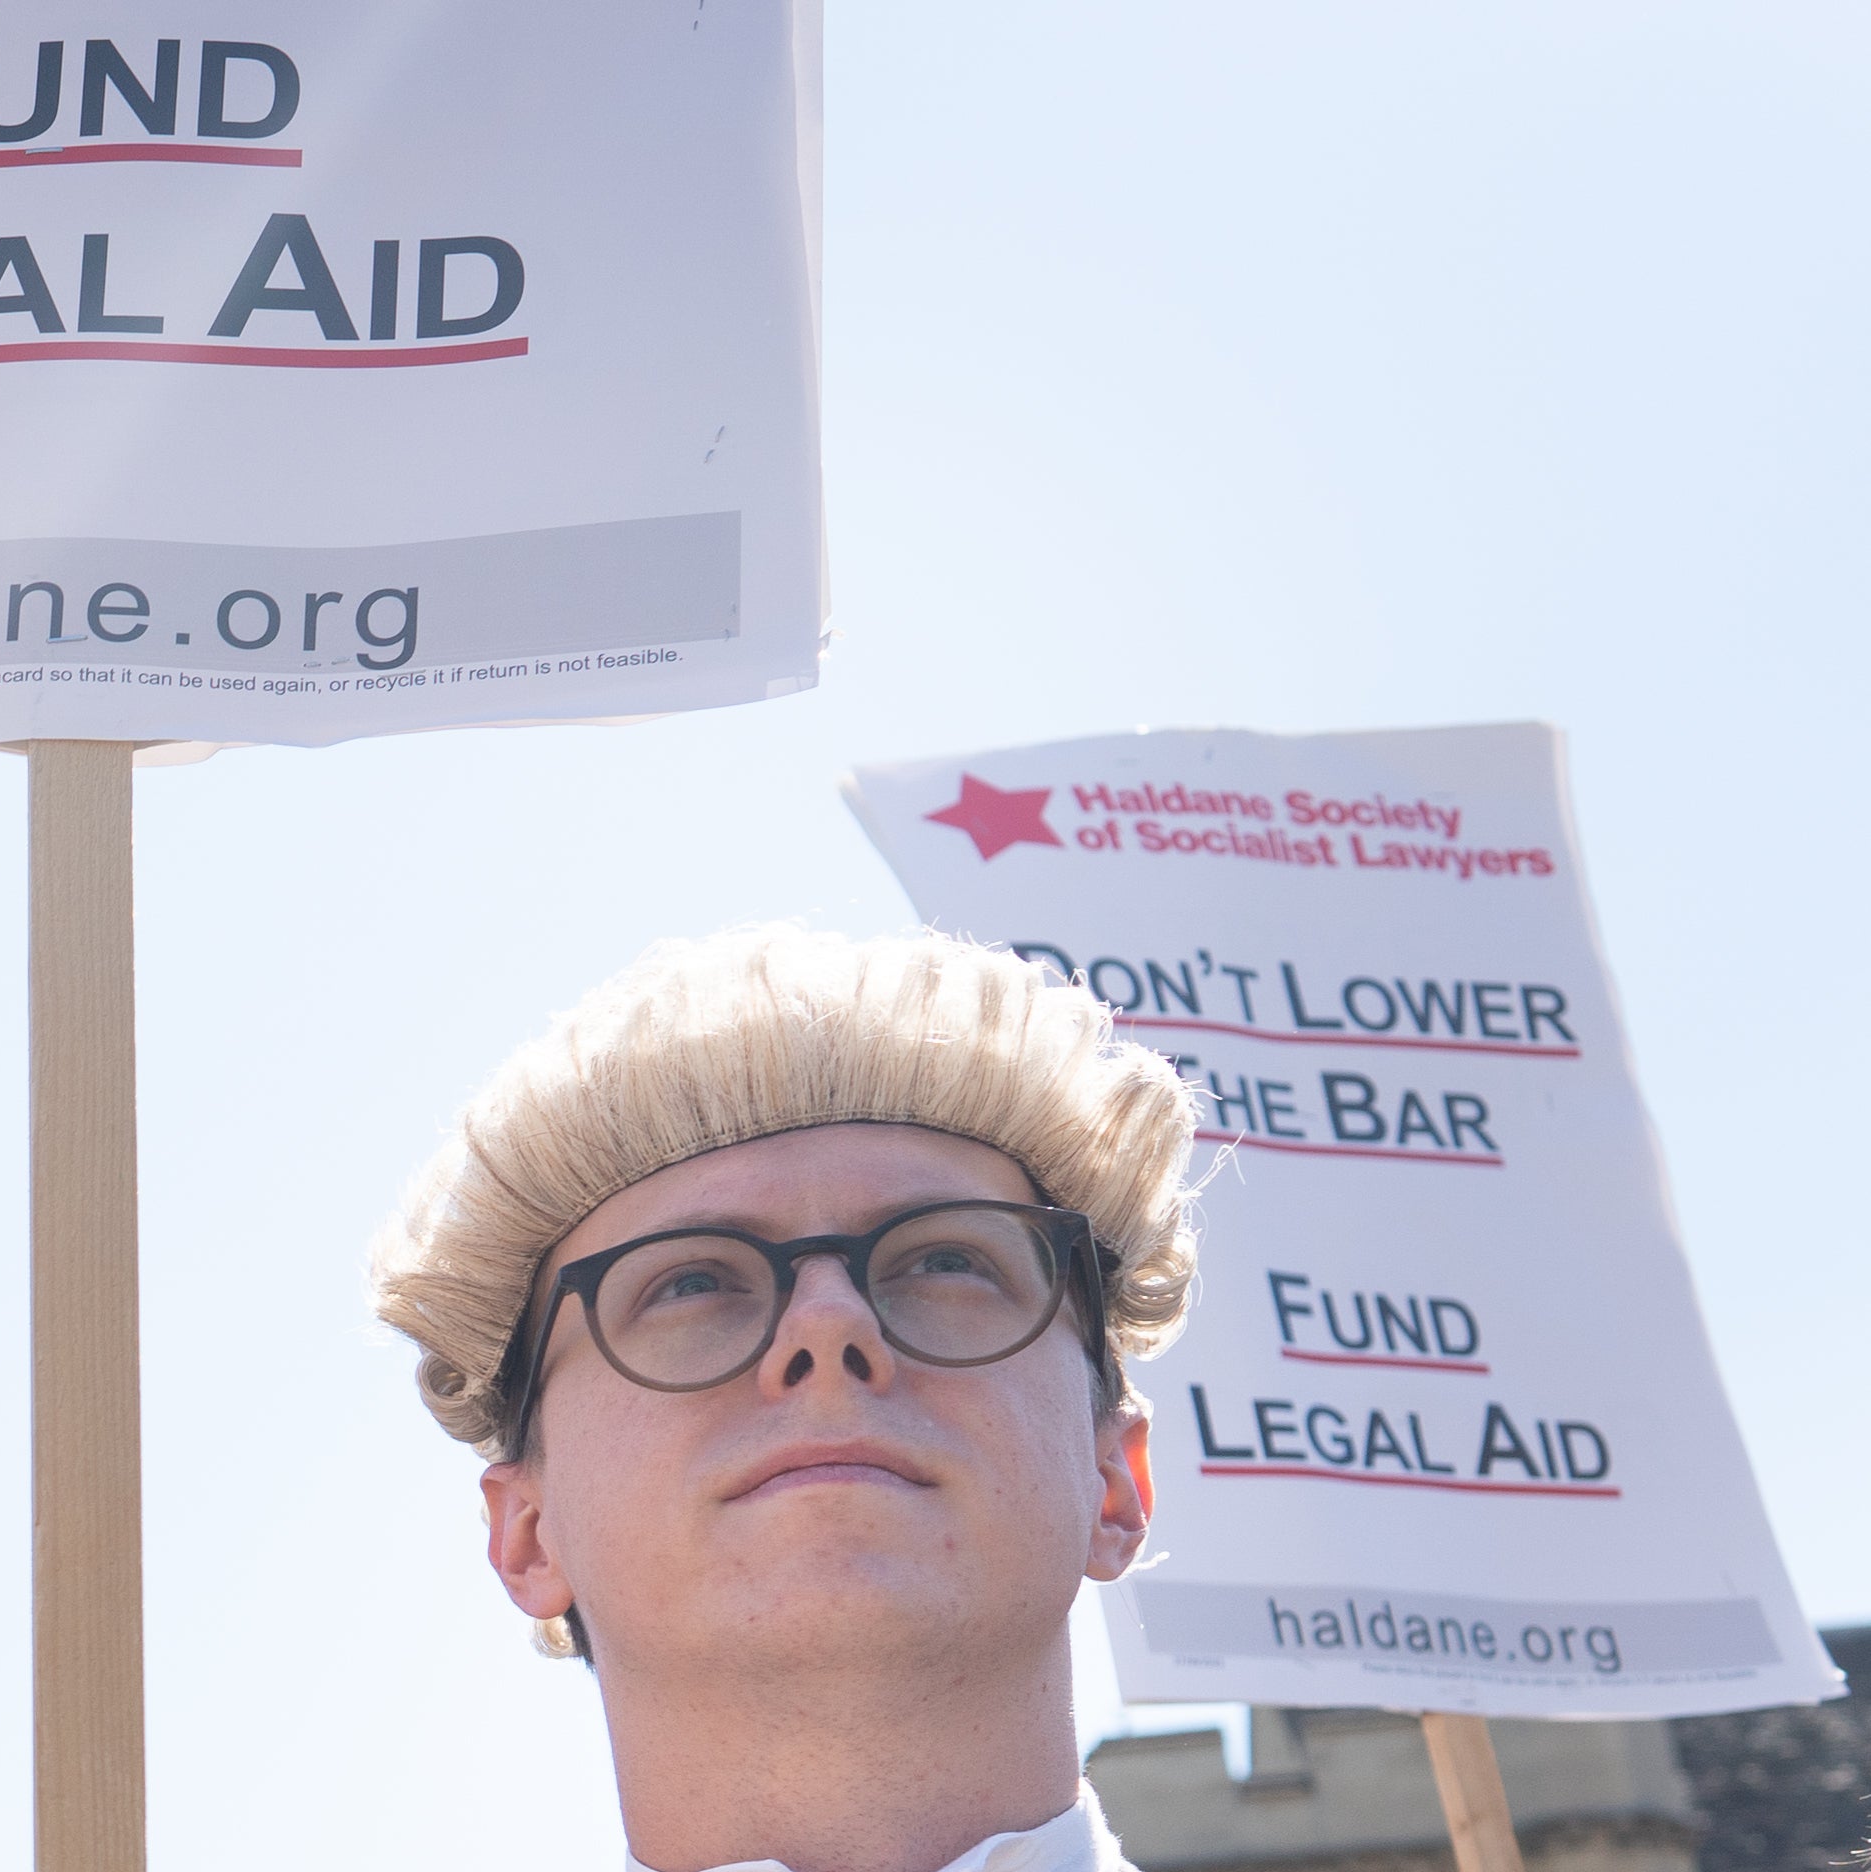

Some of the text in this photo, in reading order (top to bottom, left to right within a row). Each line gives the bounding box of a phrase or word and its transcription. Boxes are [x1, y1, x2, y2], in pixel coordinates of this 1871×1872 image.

[207, 213, 528, 343] AID
[49, 669, 72, 682] so
[79, 667, 115, 683] that
[121, 667, 132, 684] it
[137, 672, 172, 686] can
[179, 671, 202, 688] be
[209, 674, 256, 691] used
[263, 677, 323, 695] again,
[329, 678, 349, 692] or
[356, 671, 426, 693] recycle
[434, 669, 444, 685] it
[451, 667, 462, 683] if
[469, 663, 527, 682] return
[535, 659, 551, 675] is
[558, 656, 591, 673] not
[597, 648, 684, 670] feasible.
[1072, 783, 1461, 840] Haldane Society
[1075, 820, 1554, 880] of Socialist Lawyers
[1279, 962, 1576, 1045] LOWER
[1321, 1071, 1501, 1154] BAR
[1268, 1269, 1481, 1359] FUND
[1189, 1384, 1612, 1484] LEGAL AID
[1268, 1598, 1620, 1675] haldane.org
